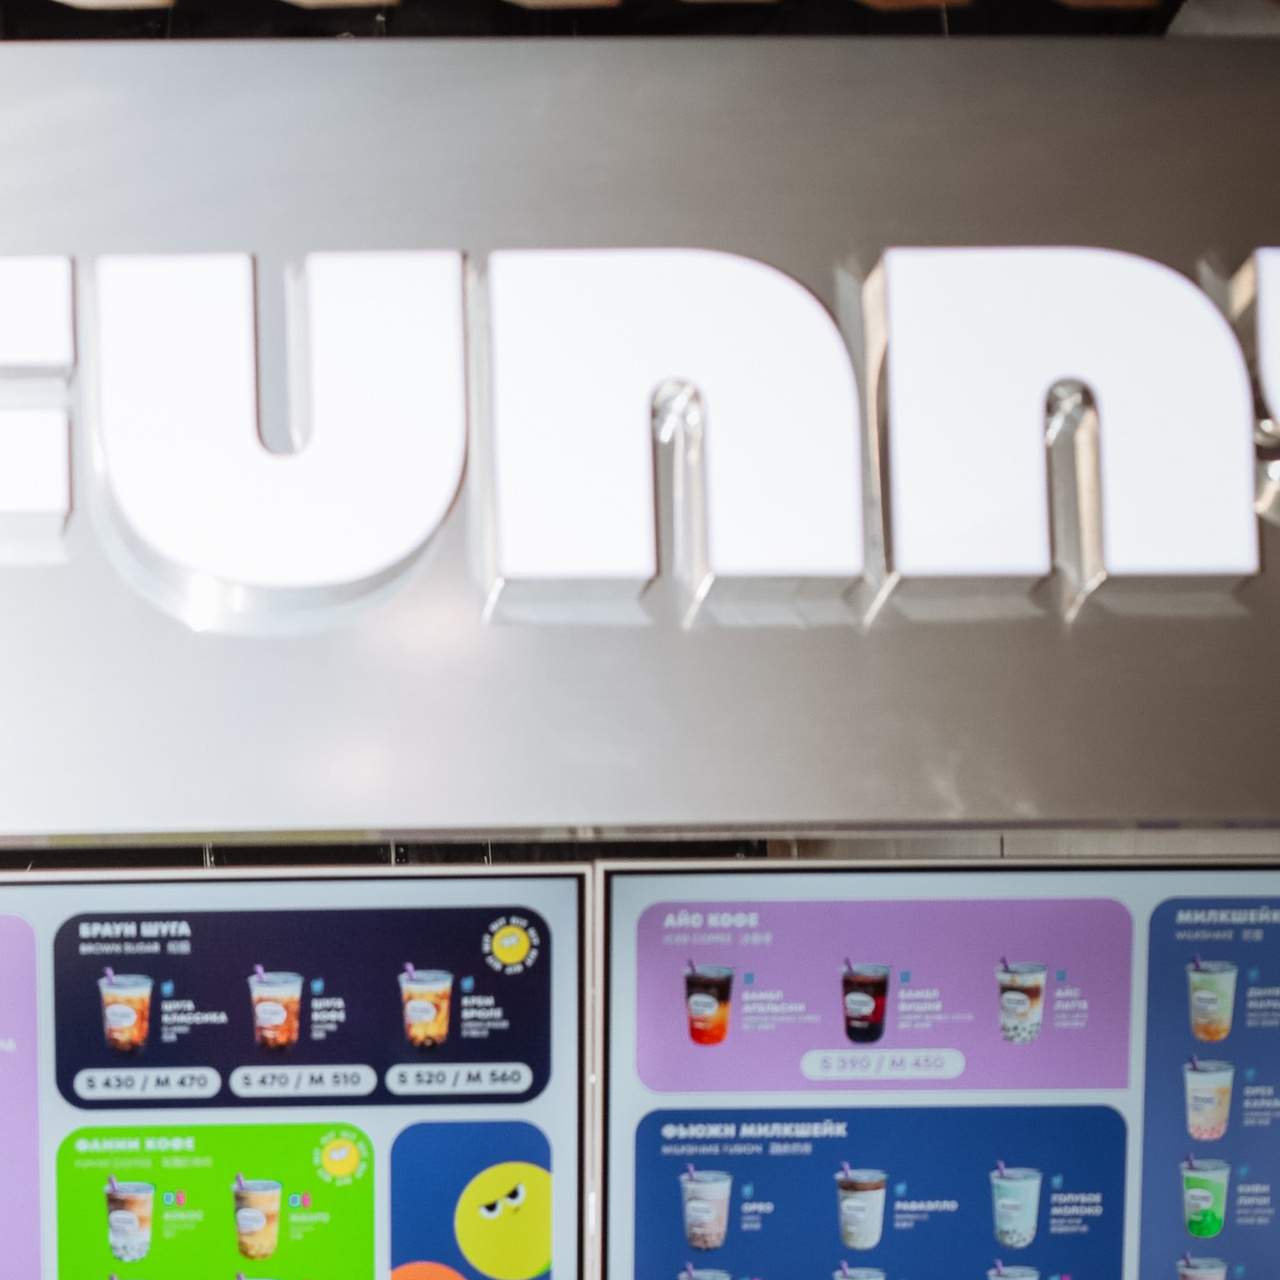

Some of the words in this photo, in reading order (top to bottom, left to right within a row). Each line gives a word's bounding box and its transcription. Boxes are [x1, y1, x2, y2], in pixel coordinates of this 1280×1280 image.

[664, 910, 704, 928] АЙС
[708, 912, 759, 928] КОФЕ
[79, 922, 137, 938] БРАУН
[140, 921, 191, 938] ШУГА
[86, 1076, 96, 1089] S
[154, 1076, 171, 1088] M
[177, 1076, 208, 1088] 470
[242, 1074, 252, 1087] S
[258, 1074, 290, 1086] 470
[308, 1074, 325, 1086] M
[397, 1071, 407, 1084] S
[466, 1071, 482, 1083] M
[661, 1123, 736, 1140] ФЬЮЖН
[740, 1119, 848, 1138] МИЛКШЕЙК
[145, 1137, 196, 1152] КОФЕ
